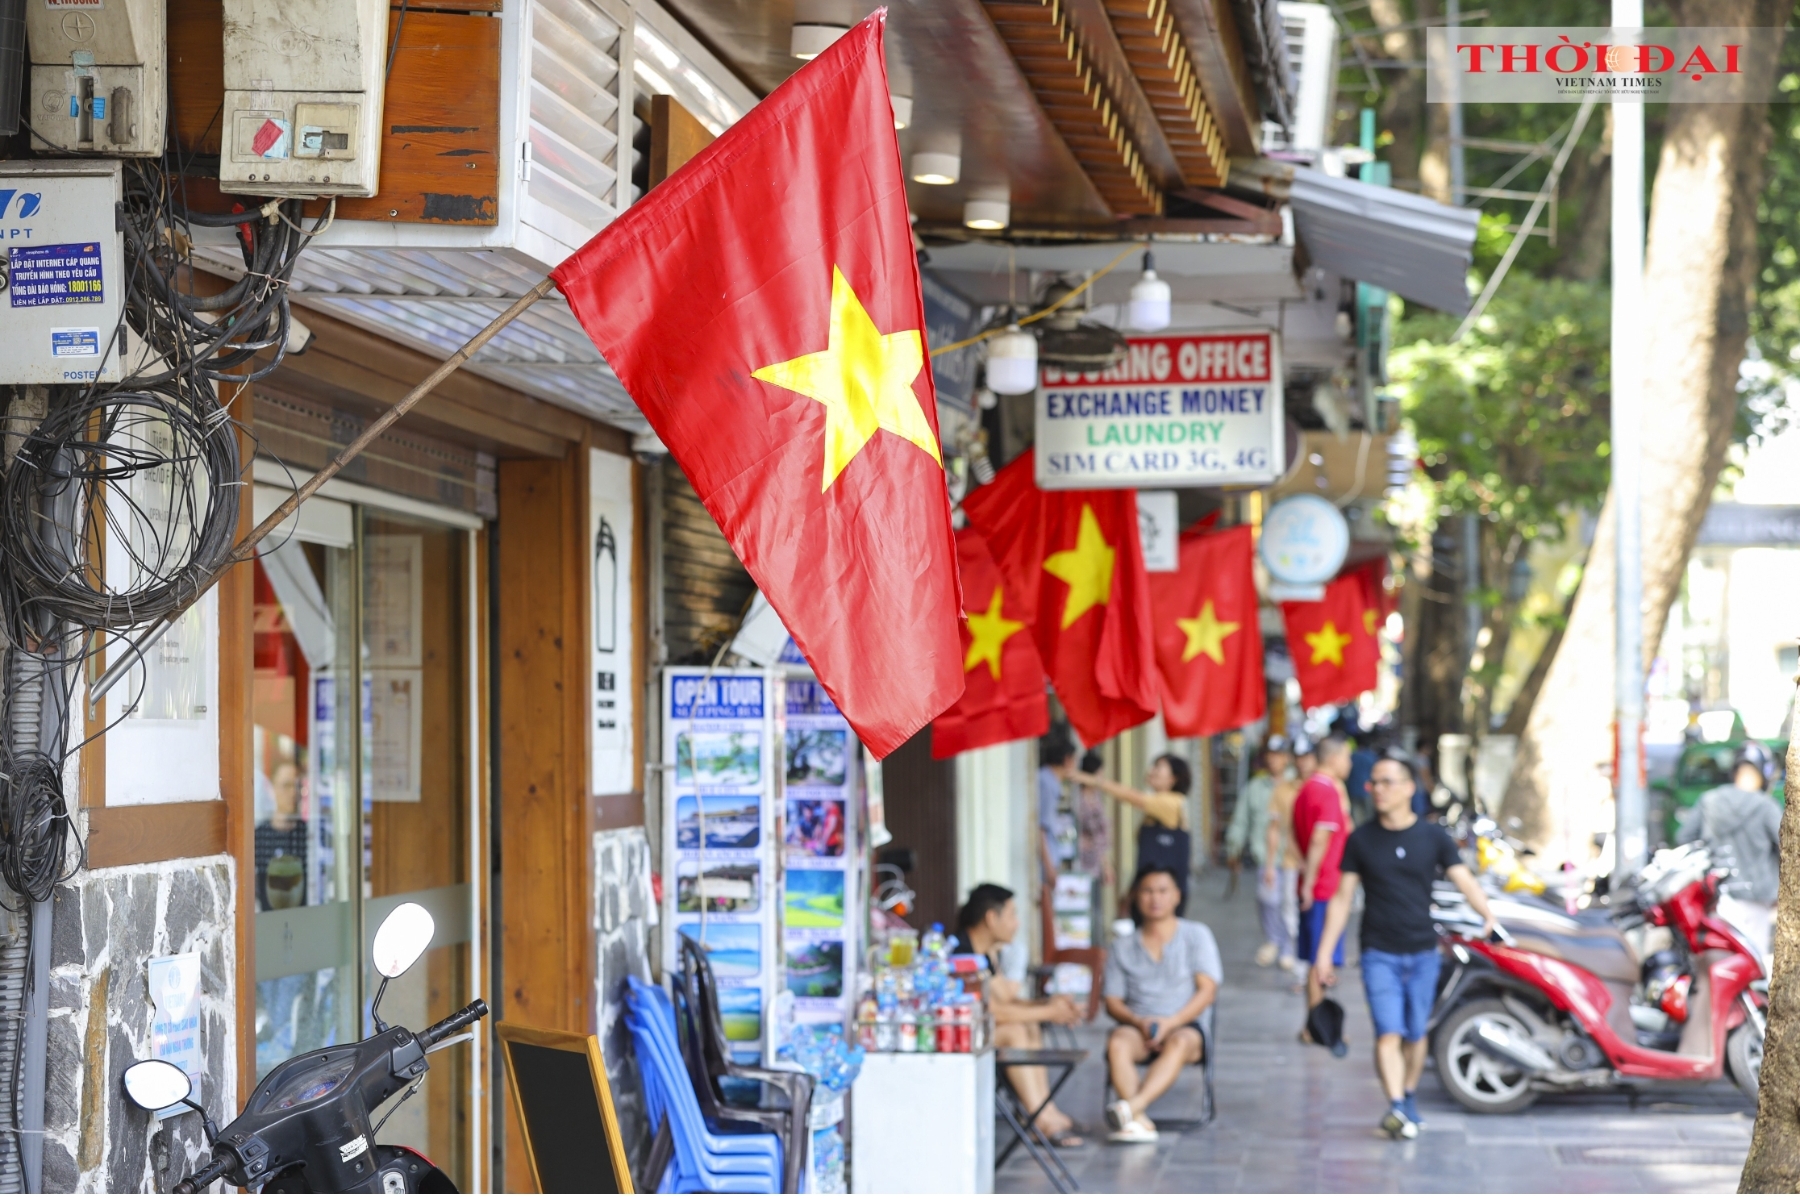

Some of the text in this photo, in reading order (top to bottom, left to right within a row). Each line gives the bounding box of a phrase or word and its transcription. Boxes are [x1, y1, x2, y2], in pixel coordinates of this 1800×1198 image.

[36, 258, 65, 268] INTERNET
[65, 257, 78, 267] CÁP
[79, 256, 100, 266] QUANG
[39, 269, 54, 279] HÌNH
[55, 270, 70, 279] THEO
[71, 267, 83, 278] YÊU
[27, 283, 37, 295] ĐÀI
[37, 282, 49, 294] BÁO
[68, 279, 102, 293] 18001166
[13, 298, 27, 306] LIÊN
[27, 297, 37, 305] HỆ
[1177, 340, 1267, 381] OFFICE
[1047, 388, 1266, 419] EXCHANGE MONEY
[1087, 421, 1225, 446] LAUNDRY
[1048, 451, 1096, 475] SIM
[1104, 450, 1180, 473] CARD
[1234, 448, 1266, 471] 4G
[674, 679, 762, 707] OPEN TOUR
